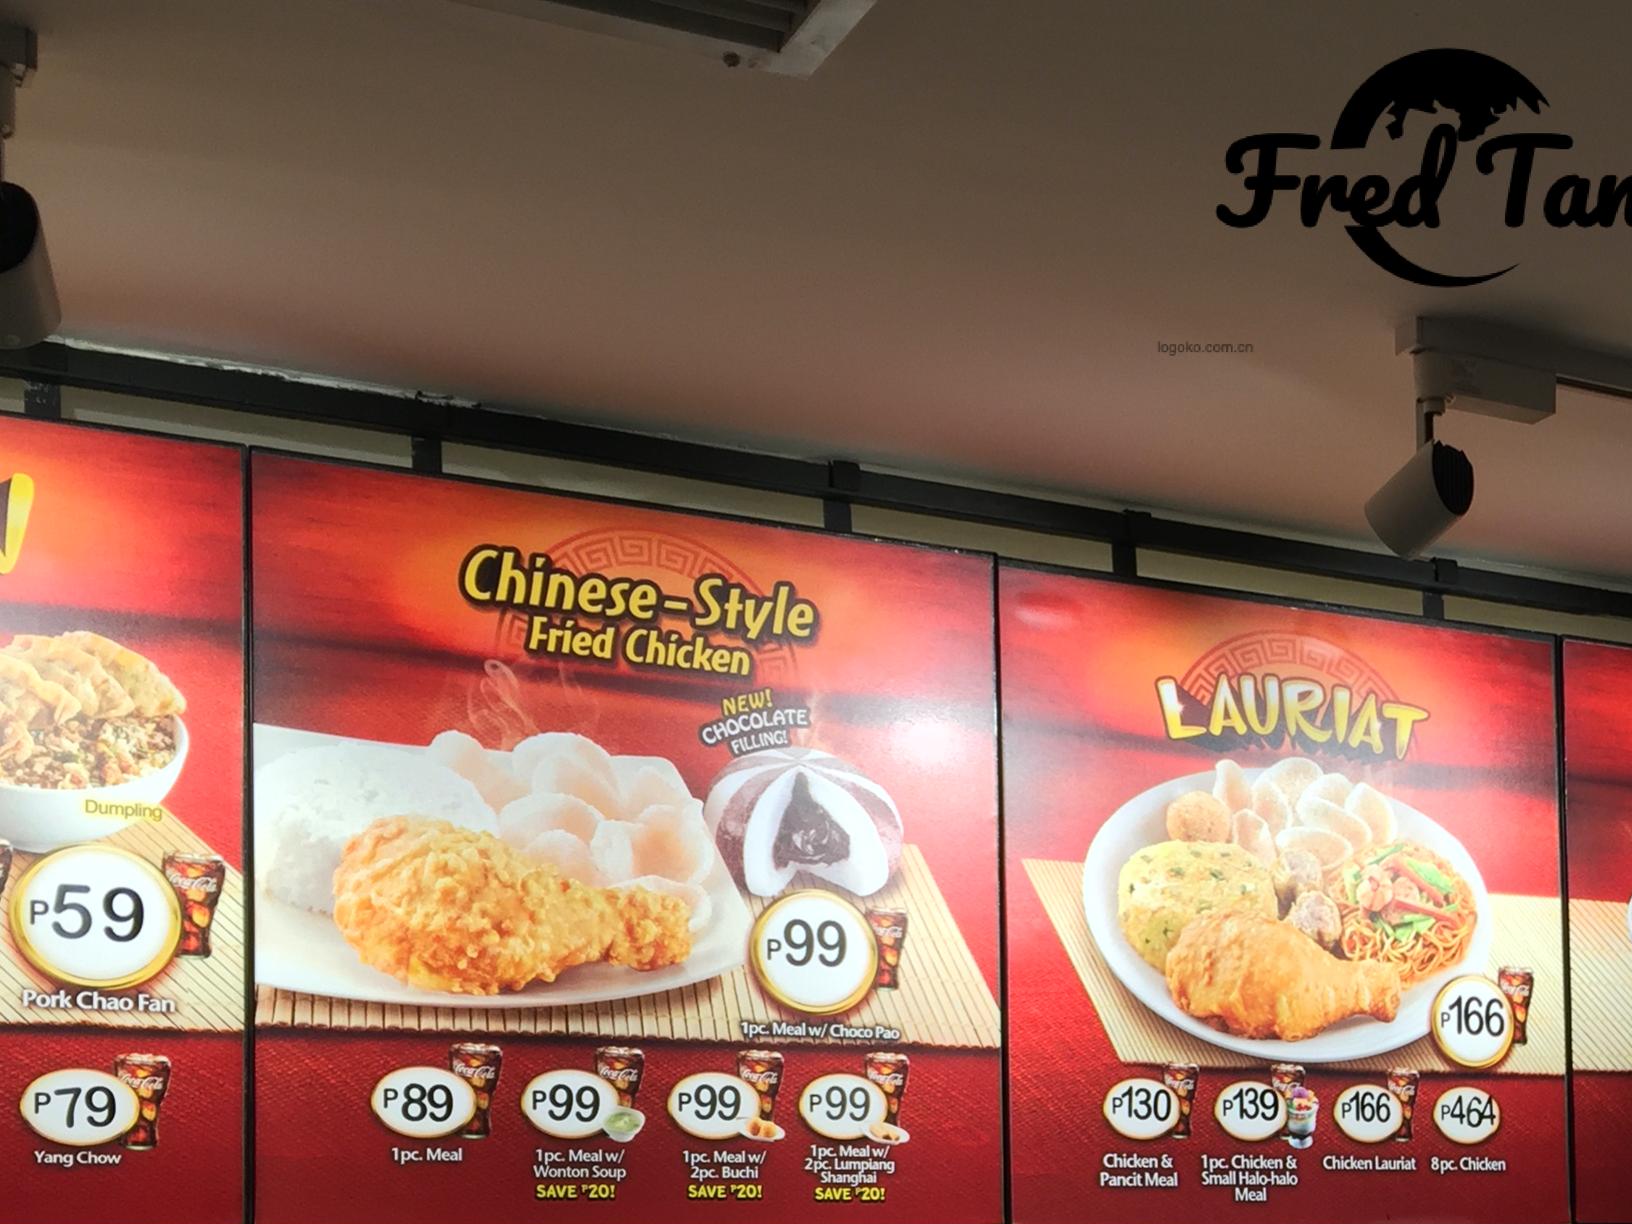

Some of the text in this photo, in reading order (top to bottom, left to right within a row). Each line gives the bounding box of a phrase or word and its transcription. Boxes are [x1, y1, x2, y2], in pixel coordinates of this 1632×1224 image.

[528, 615, 751, 676] Fried Chicken
[723, 688, 774, 717] NEW!
[702, 706, 808, 743] CHOCOLATE
[1155, 672, 1431, 761] LAURIAT
[731, 728, 789, 755] FILLING!
[84, 798, 163, 822] Dumpling
[22, 988, 176, 1014] Pork Chao Fan
[741, 1021, 901, 1041] 1pc. Meal w/ Choco Pao
[34, 1149, 122, 1168] Yang Chow
[392, 1147, 463, 1165] 1pc. Meal
[537, 1149, 625, 1167] 1pc. Meal w/
[682, 1150, 767, 1168] 1pc. Meal w/
[811, 1144, 890, 1161] 1pc. Meal w/
[1103, 1153, 1173, 1170] Chicken &
[804, 1158, 832, 1174] 2pc.
[1201, 1154, 1297, 1173] 1pc. Chicken &
[1323, 1155, 1416, 1172] Chicken Lauriat
[1459, 1156, 1506, 1173] Chicken
[533, 1165, 627, 1183] Wonton Soup
[690, 1165, 759, 1184] 2pc. Buchi
[820, 1171, 877, 1188] Shanghai
[1100, 1171, 1178, 1188] Pancit Meal
[1201, 1171, 1298, 1187] Small Halo-halo
[536, 1185, 577, 1199] SAVE
[688, 1185, 727, 1199] SAVE
[815, 1186, 852, 1201] SAVE
[1235, 1186, 1267, 1203] Meal
